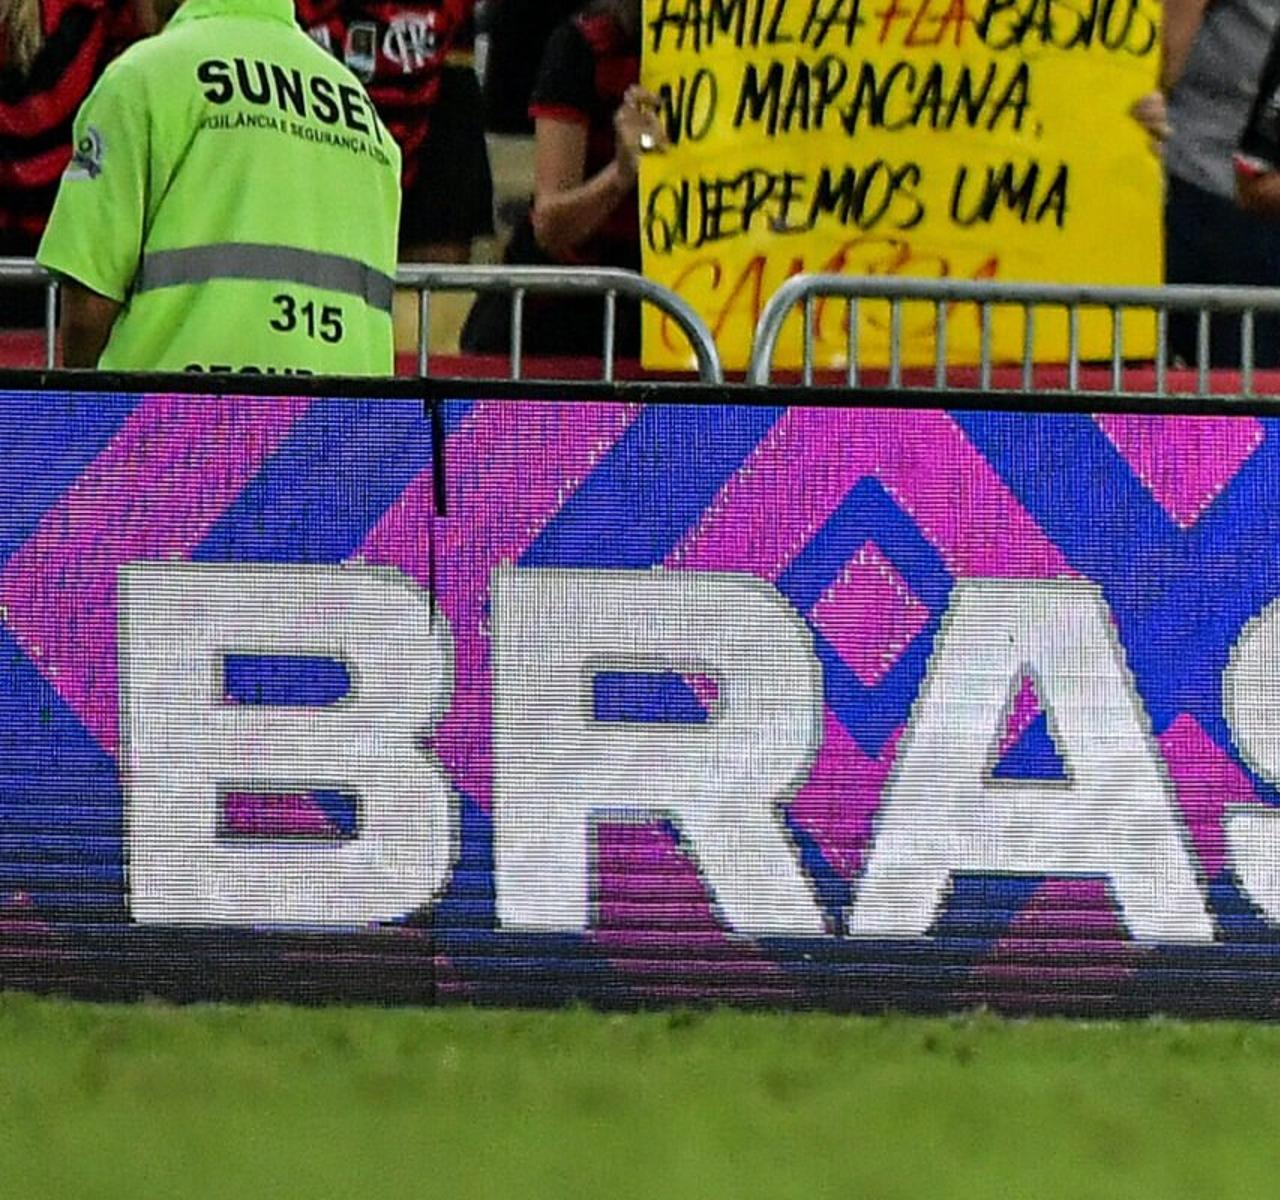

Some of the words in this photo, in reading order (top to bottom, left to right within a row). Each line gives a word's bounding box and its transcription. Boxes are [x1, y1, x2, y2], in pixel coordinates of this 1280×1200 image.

[645, 158, 925, 256] QUEREMOS
[951, 160, 1070, 228] UMA
[270, 294, 344, 344] 315
